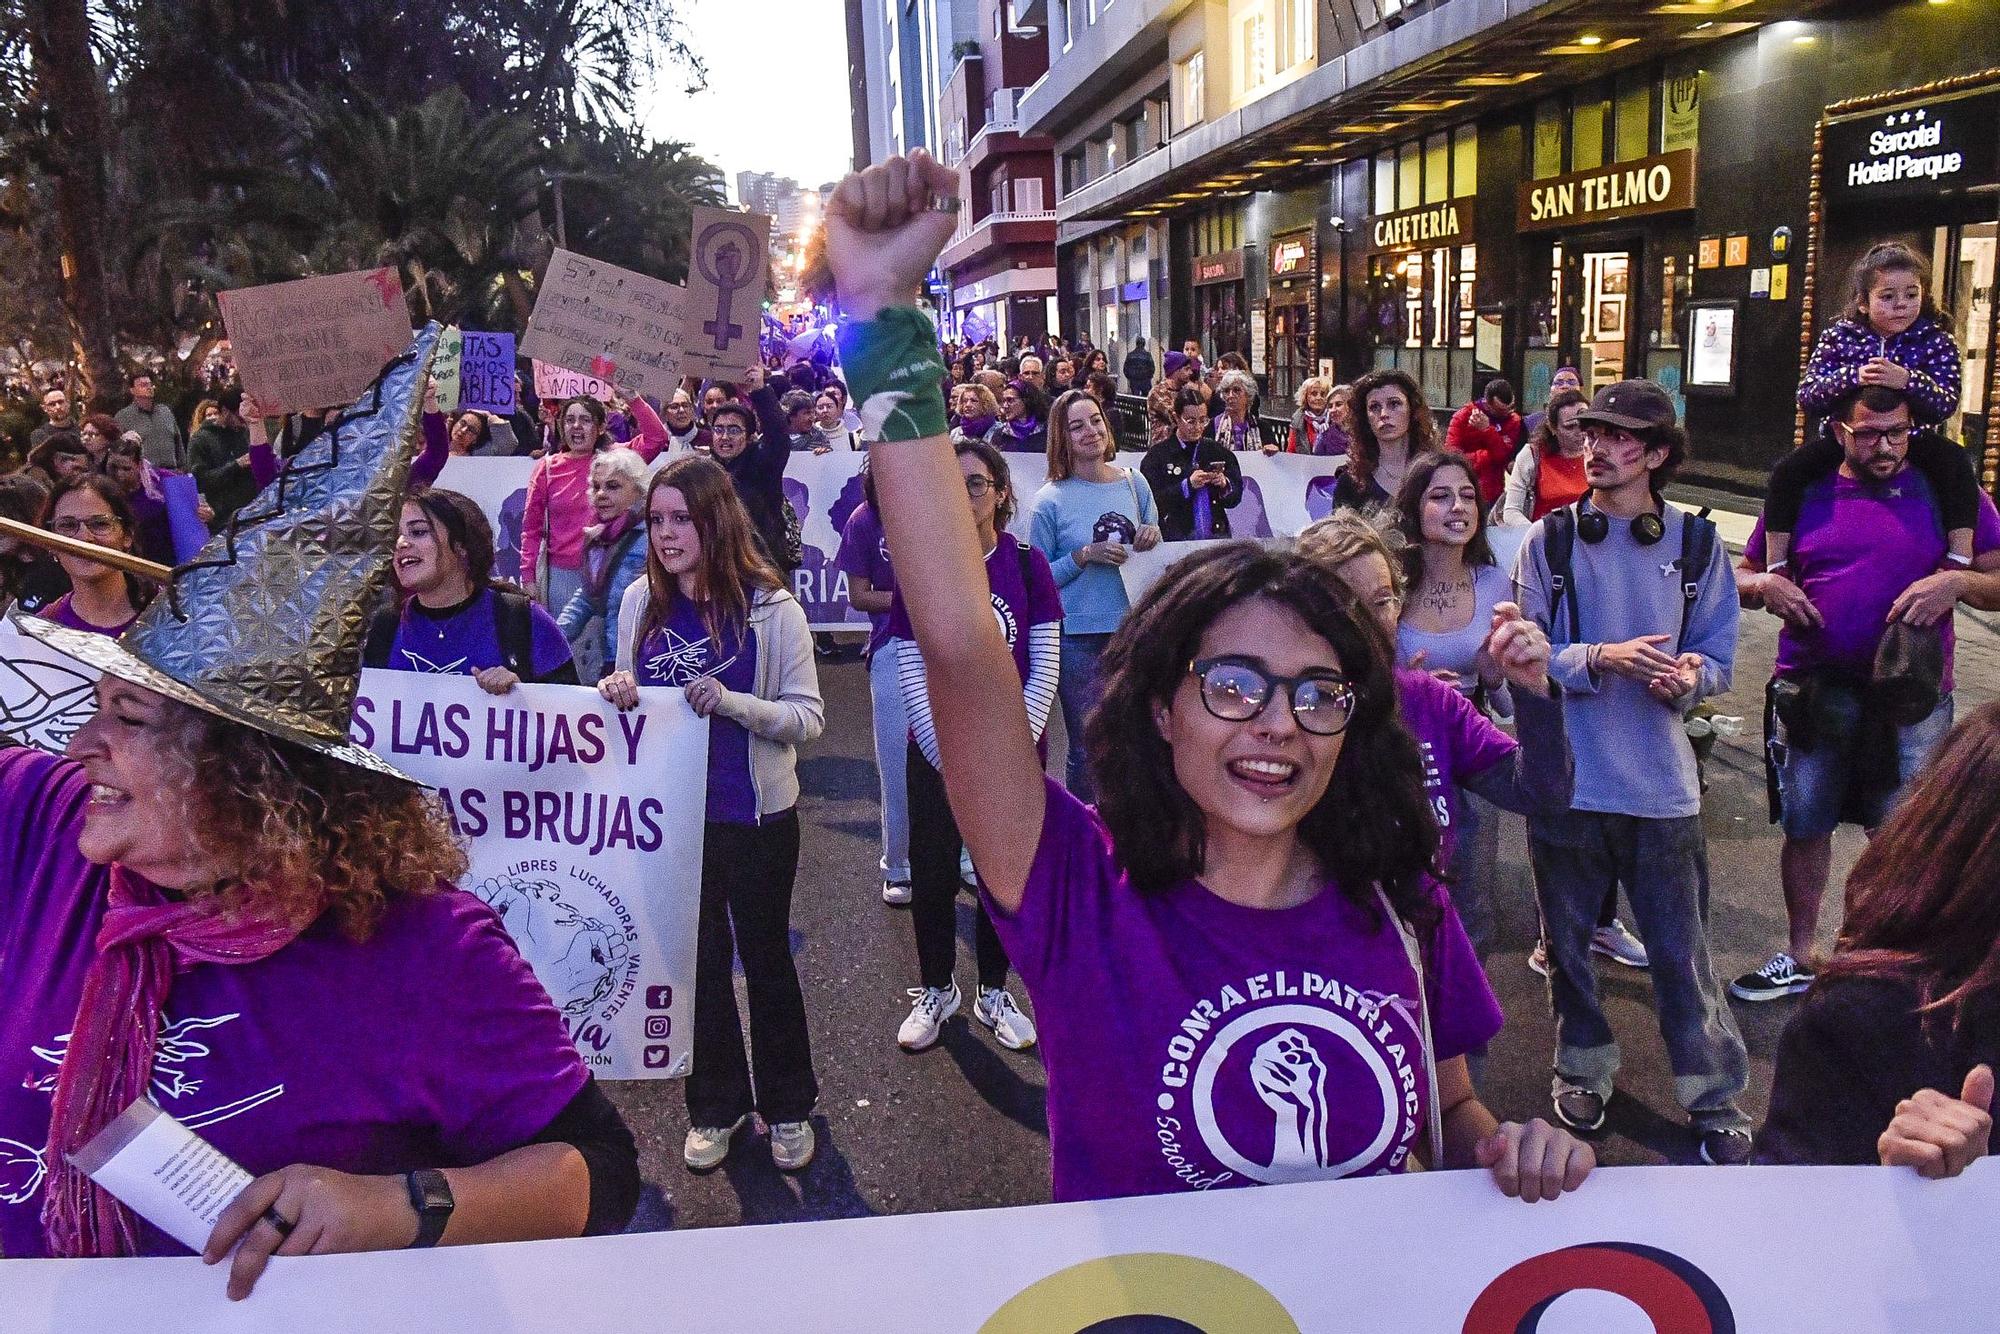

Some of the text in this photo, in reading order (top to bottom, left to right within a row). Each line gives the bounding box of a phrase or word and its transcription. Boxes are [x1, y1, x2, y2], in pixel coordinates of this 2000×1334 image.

[1869, 120, 1941, 156] Sercotel
[1848, 152, 1961, 186] Hotel Parque
[1530, 164, 1671, 222] SAN TELMO
[1374, 203, 1460, 247] CAFETERÍA
[459, 374, 513, 405] ABLES
[461, 361, 508, 375] OMOS
[794, 559, 850, 603] RÍA
[392, 700, 471, 758] LAS
[485, 707, 605, 772] HIJAS
[618, 713, 647, 765] Y
[438, 787, 664, 856] AS BRUJAS
[508, 859, 641, 1022] LIBRES LUCHADORAS VALIENTES
[1246, 970, 1298, 1001] EL
[583, 1052, 612, 1065] CIÓN
[1156, 1115, 1233, 1192] Sororid
